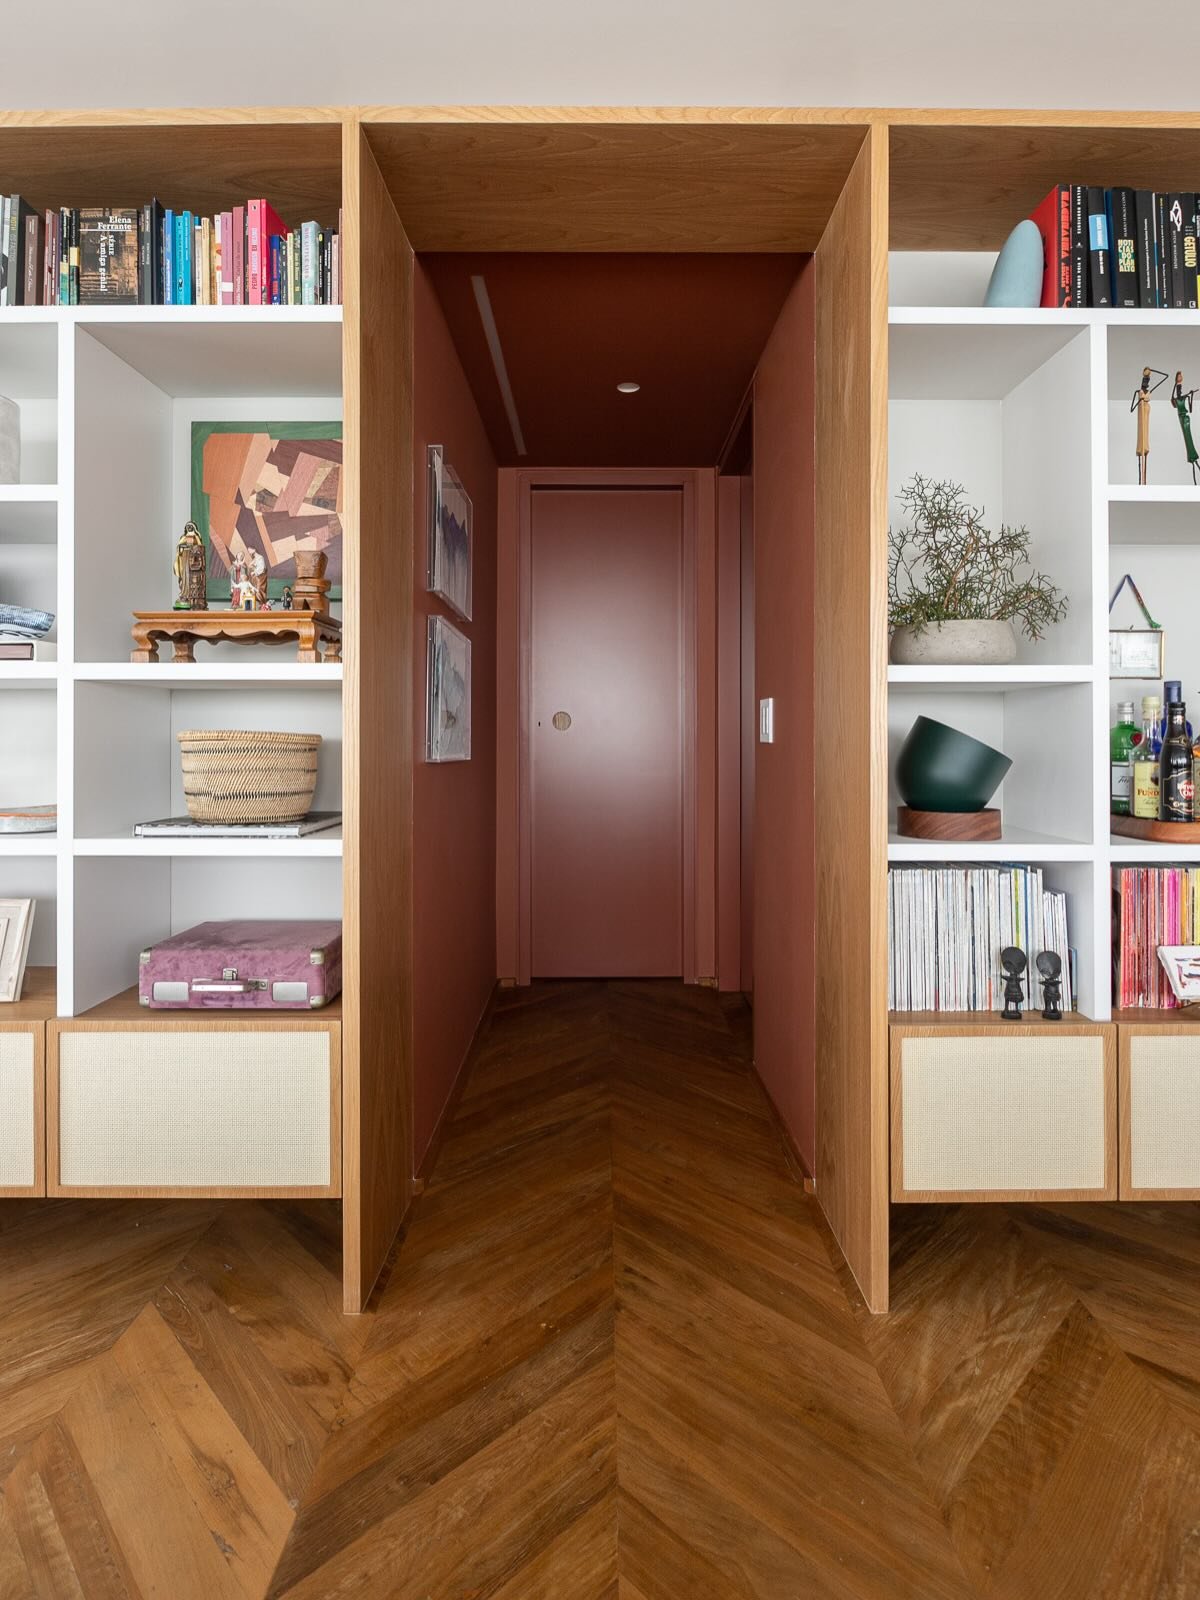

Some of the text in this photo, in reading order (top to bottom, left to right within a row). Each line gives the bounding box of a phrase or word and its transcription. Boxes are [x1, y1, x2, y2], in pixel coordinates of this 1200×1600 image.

[109, 216, 132, 224] Elena
[1170, 200, 1182, 232] AMY
[97, 222, 132, 231] Ferrante
[98, 243, 108, 267] amiga
[98, 268, 109, 292] genial
[1137, 788, 1160, 796] FUND
